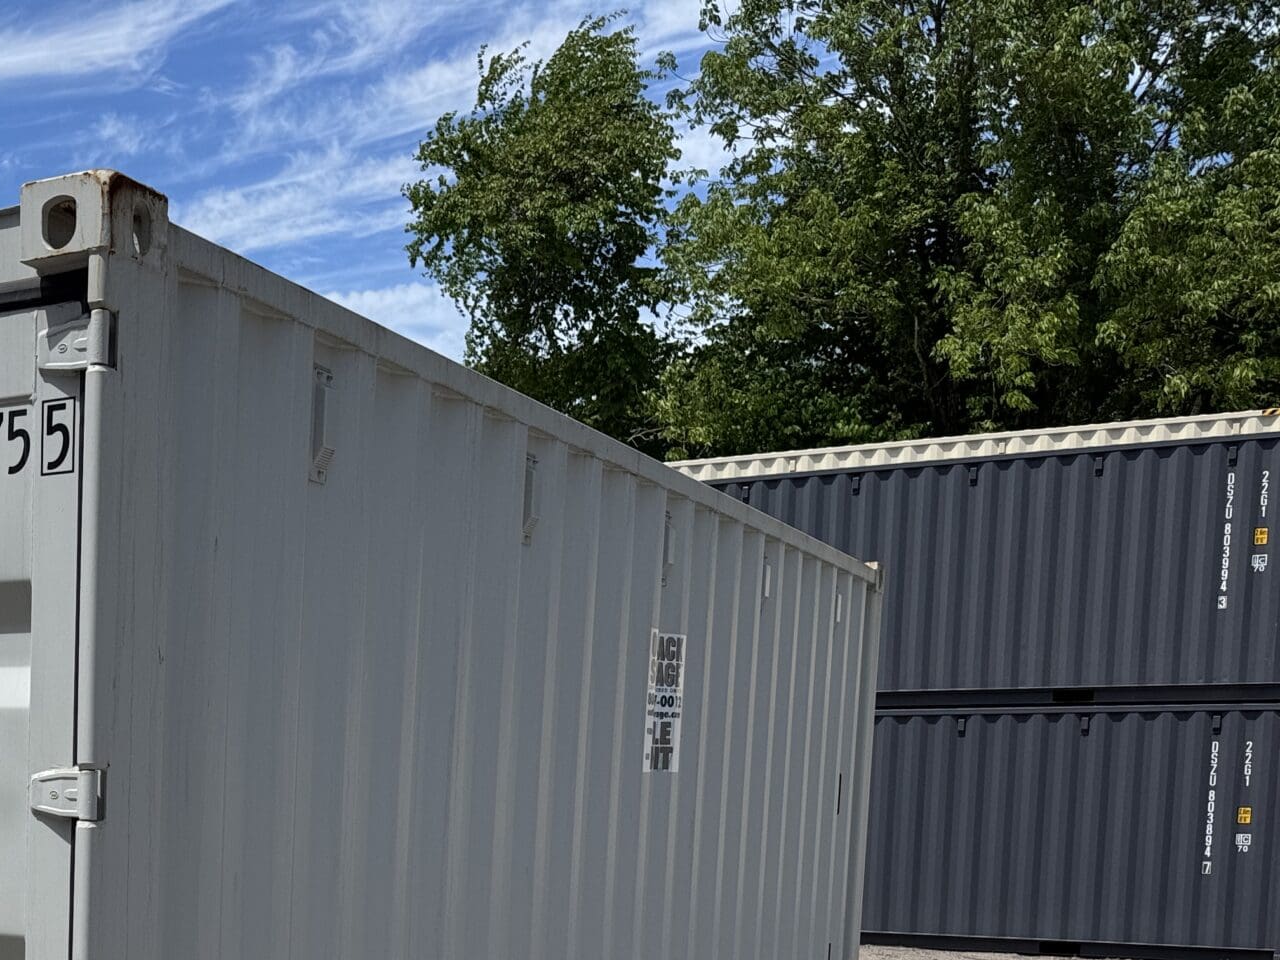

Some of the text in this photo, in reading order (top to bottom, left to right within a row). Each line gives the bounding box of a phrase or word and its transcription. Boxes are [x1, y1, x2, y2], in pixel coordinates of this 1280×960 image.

[47, 403, 70, 470] 5
[1225, 472, 1235, 520] DSZU
[1260, 470, 1270, 518] 22G1
[1209, 741, 1219, 787] DSZU
[1244, 741, 1253, 787] 22G1
